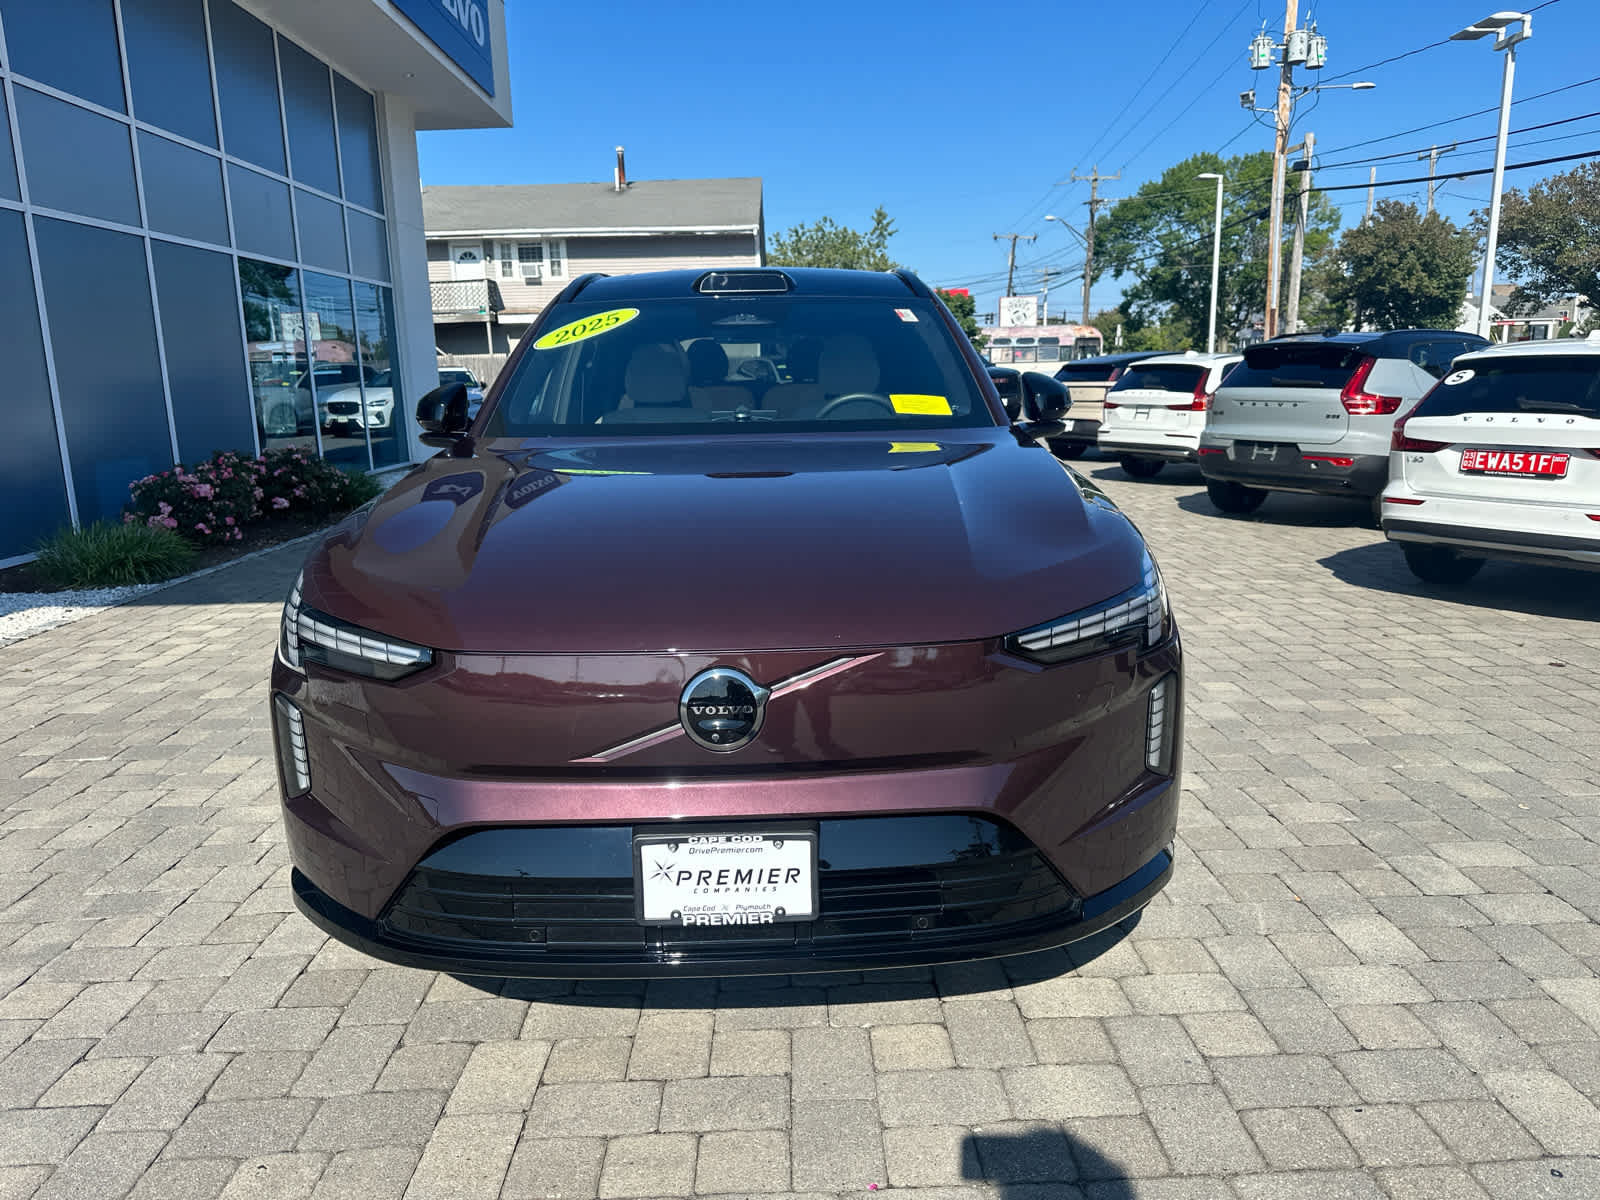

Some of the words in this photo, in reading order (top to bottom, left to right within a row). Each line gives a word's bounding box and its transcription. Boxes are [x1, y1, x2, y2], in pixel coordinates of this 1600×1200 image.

[555, 312, 620, 344] 2025
[1462, 416, 1575, 424] VOLVO
[690, 705, 754, 715] VOLVO
[687, 836, 727, 845] CAPE
[731, 835, 763, 844] COD
[675, 868, 800, 886] PREMIER
[693, 886, 777, 894] COMPANIES
[682, 912, 774, 926] PREMIER
